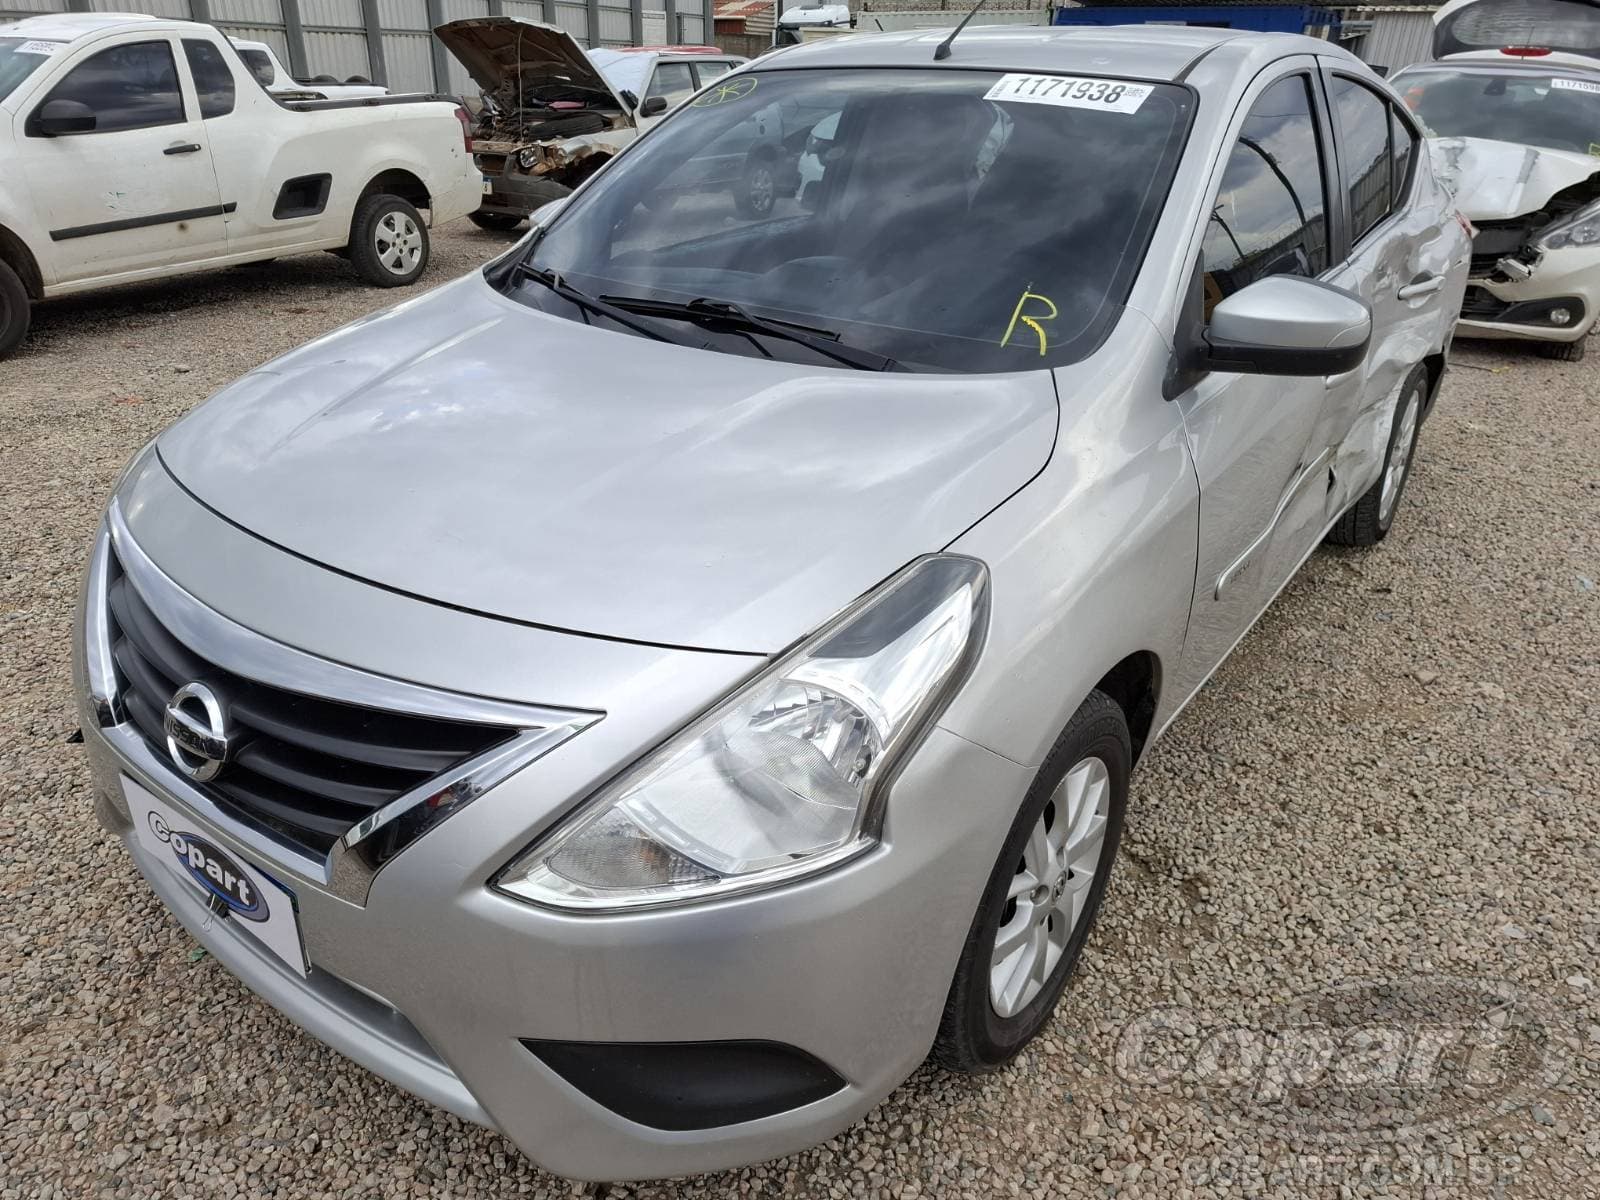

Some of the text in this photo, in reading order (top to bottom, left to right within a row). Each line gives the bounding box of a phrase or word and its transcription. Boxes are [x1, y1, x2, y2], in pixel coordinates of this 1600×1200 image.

[1013, 77, 1127, 104] 1171938
[1000, 291, 1058, 356] R
[147, 810, 250, 906] Copart
